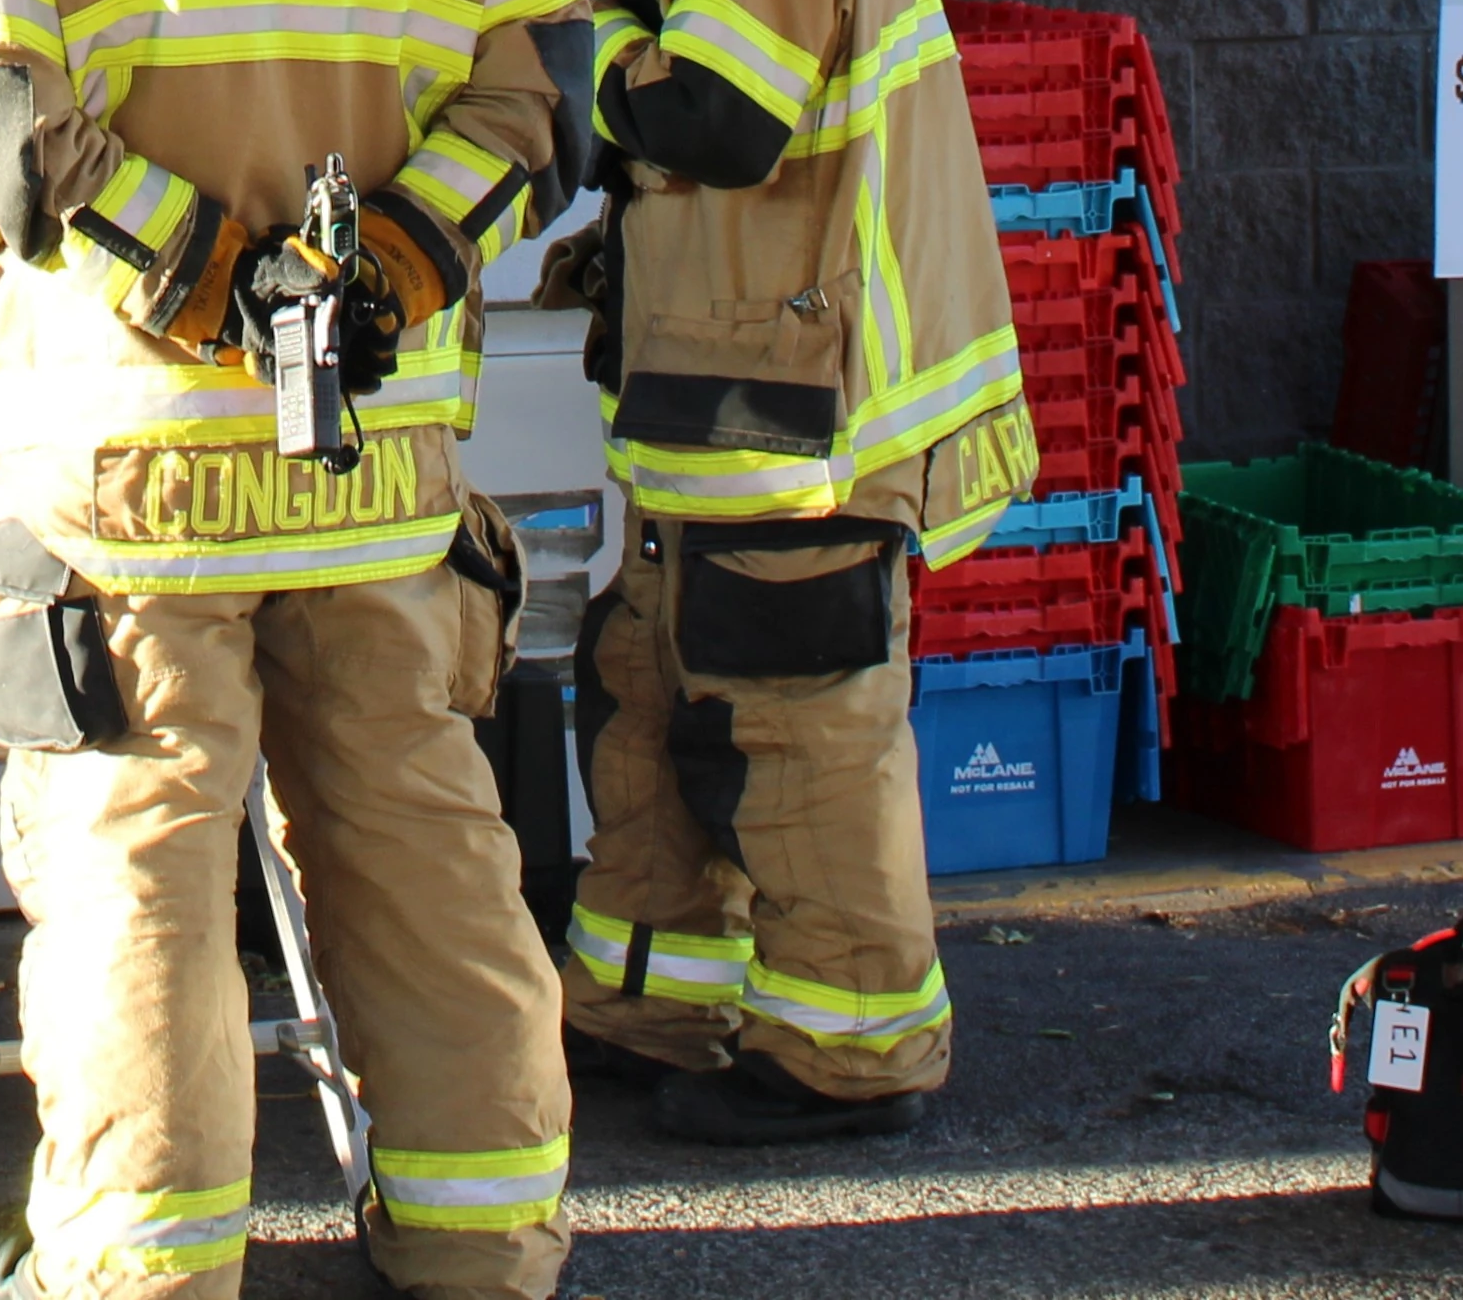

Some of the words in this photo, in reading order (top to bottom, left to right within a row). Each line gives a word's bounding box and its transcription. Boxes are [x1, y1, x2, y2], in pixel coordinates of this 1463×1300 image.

[146, 437, 417, 536] CONGDON
[950, 784, 972, 795] NOT
[974, 782, 995, 793] FOR
[997, 780, 1036, 791] RESALE
[1389, 1023, 1421, 1065] E1
